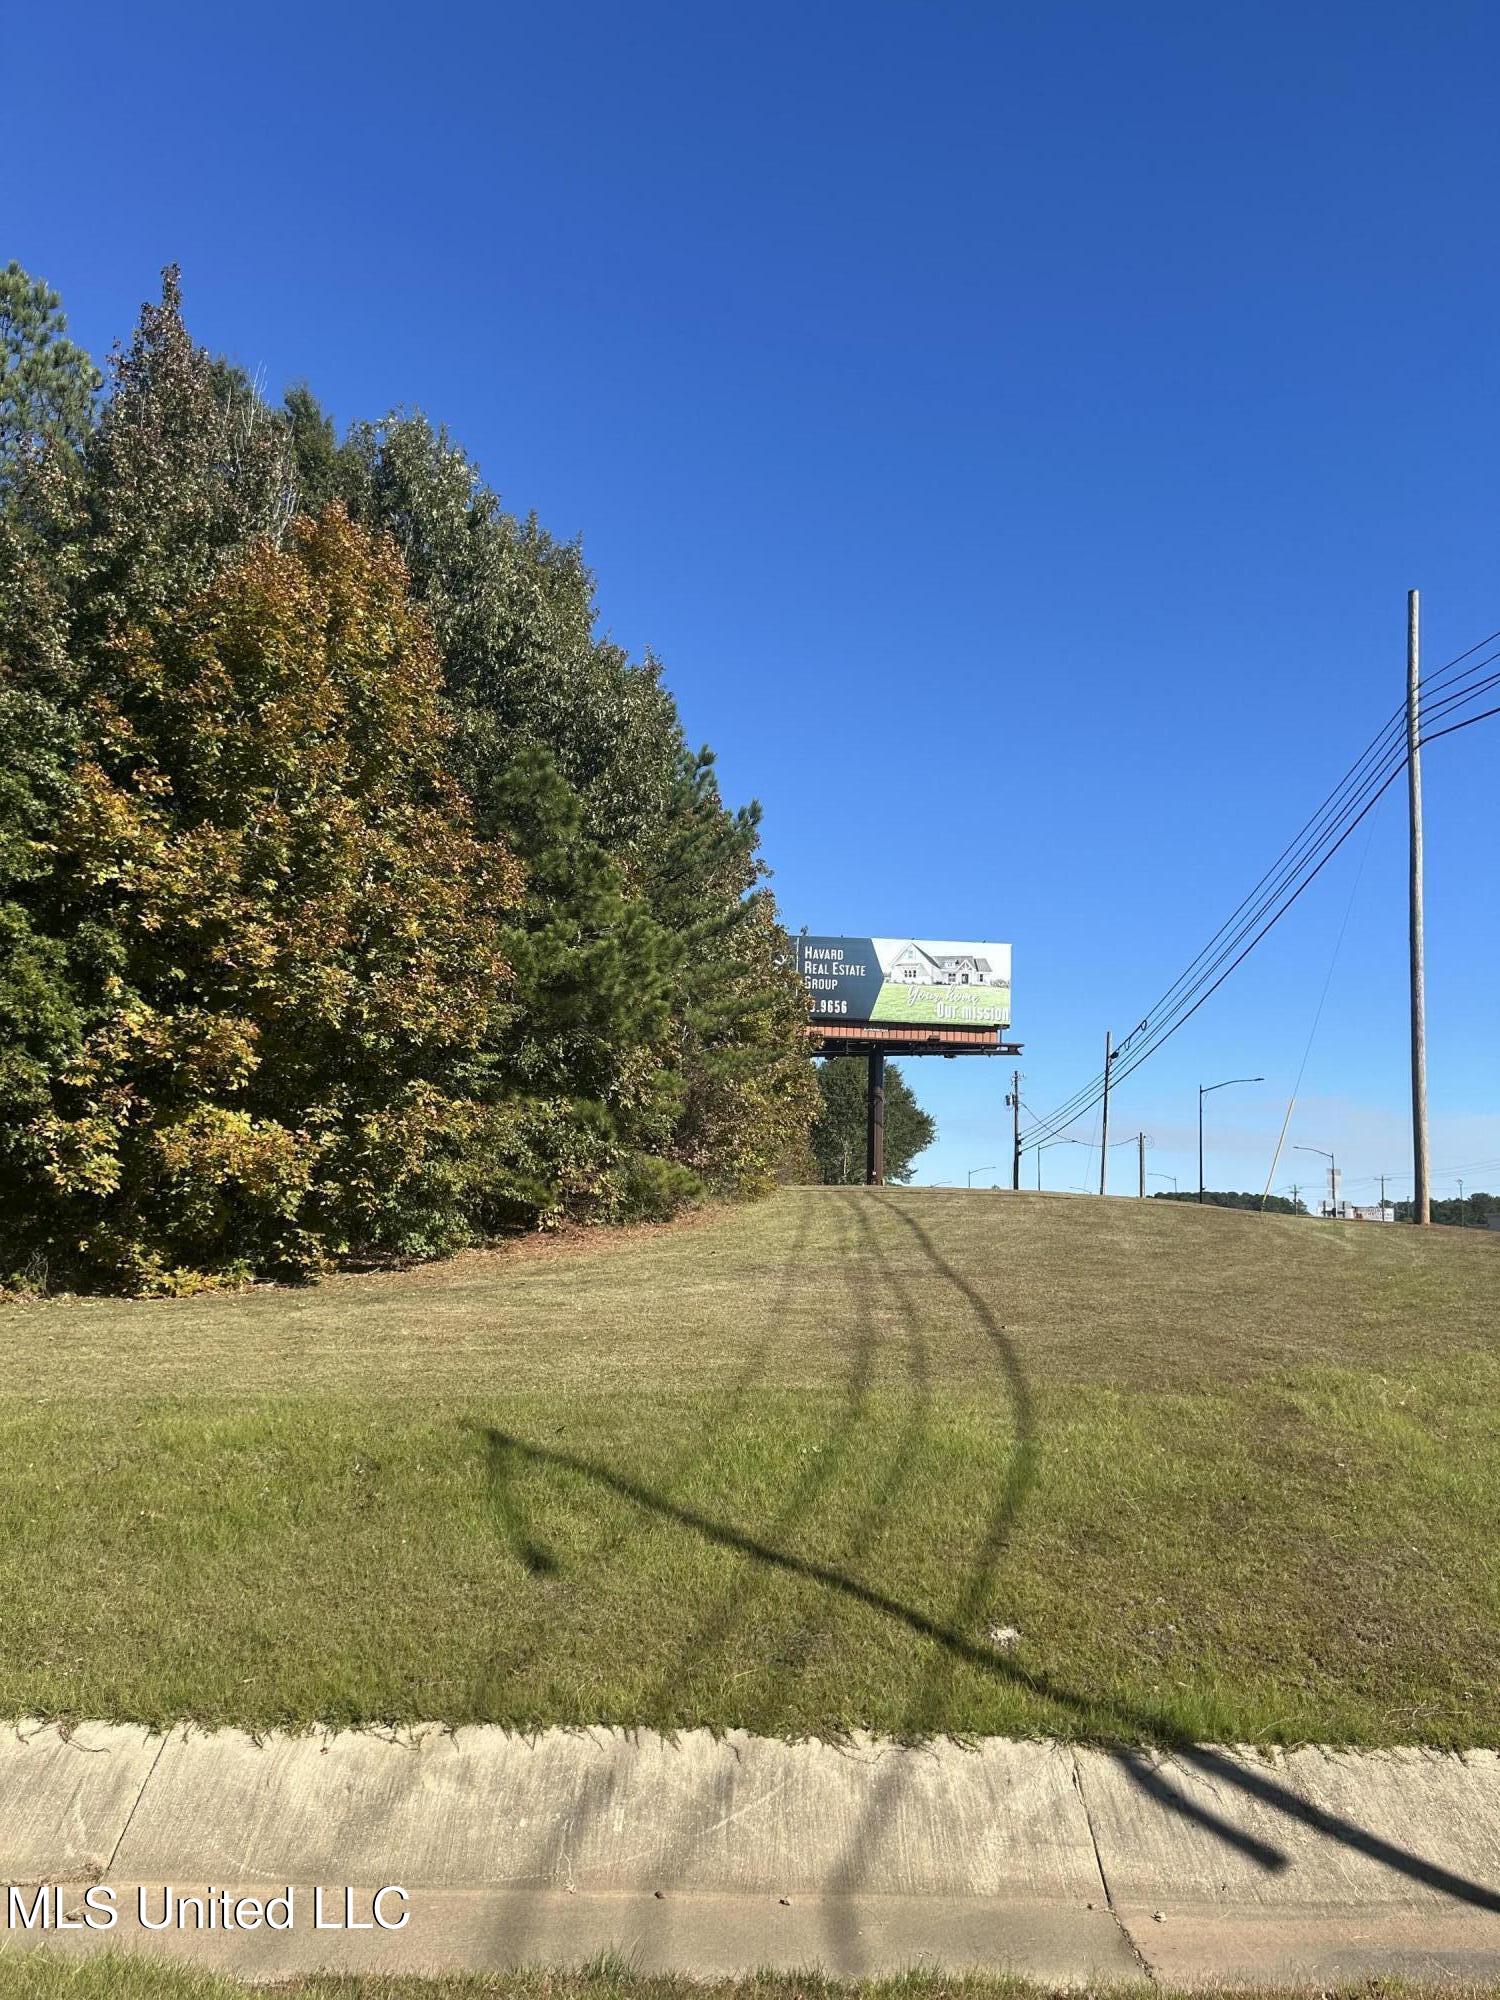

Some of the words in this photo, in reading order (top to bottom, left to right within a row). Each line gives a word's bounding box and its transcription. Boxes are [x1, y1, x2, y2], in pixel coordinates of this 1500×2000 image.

[804, 946, 844, 960] HAVARD
[804, 961, 829, 975] REAL
[832, 962, 867, 976] ESTATE
[804, 976, 838, 990] GROUP
[906, 984, 941, 1007] Your
[936, 1001, 956, 1019] Our
[962, 1005, 1009, 1021] mission
